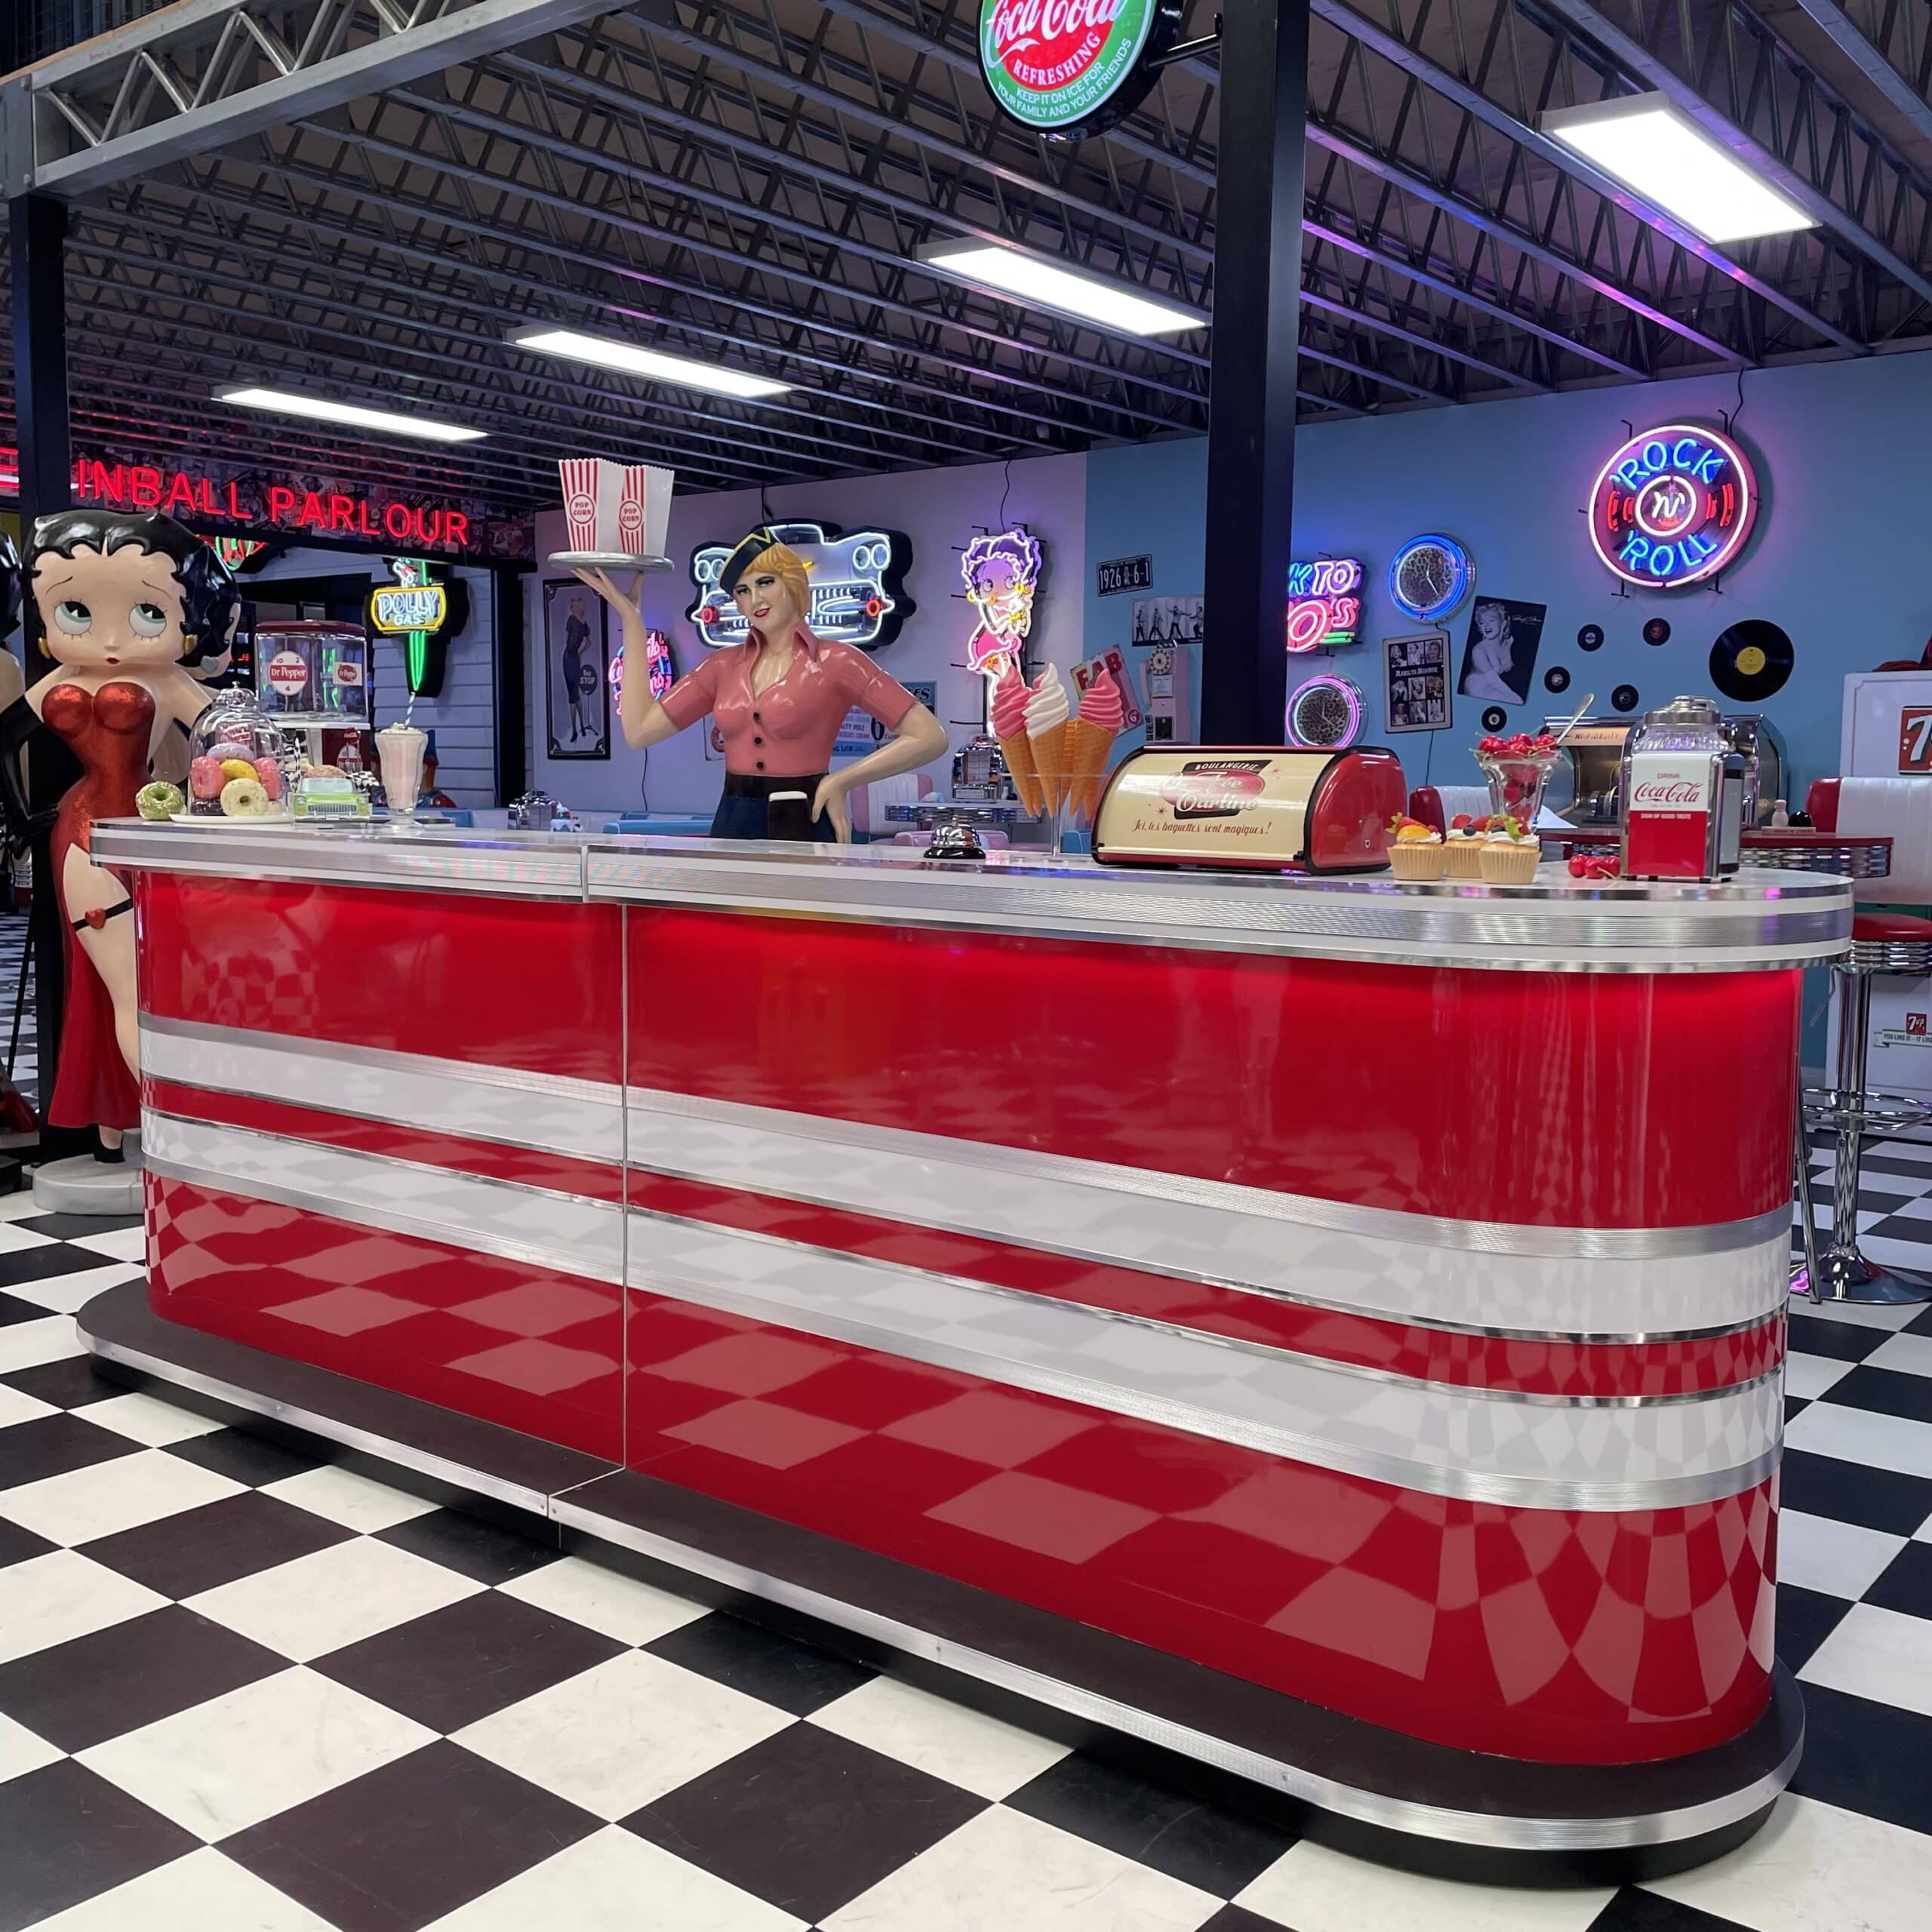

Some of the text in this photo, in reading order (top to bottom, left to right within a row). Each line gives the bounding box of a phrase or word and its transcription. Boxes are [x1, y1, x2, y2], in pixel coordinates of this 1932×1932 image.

[1013, 32, 1101, 85] REFRESHING
[997, 38, 1131, 118] YOUR FAMILY AND YOUR FRIENDS
[1017, 61, 1105, 104] KEEP IT ON ICE FOR
[78, 459, 253, 520] INBALL
[269, 486, 469, 546] PARLOUR
[1100, 567, 1121, 591] 1926
[1312, 561, 1355, 595] TO
[377, 591, 440, 622] POLLY
[393, 614, 425, 626] GAS
[281, 667, 306, 678] Pepper
[1195, 761, 1260, 771] BOULANGERIE
[1634, 781, 1703, 802] Coca-Cola
[1161, 822, 1201, 834] baguettes
[1204, 824, 1223, 833] sont
